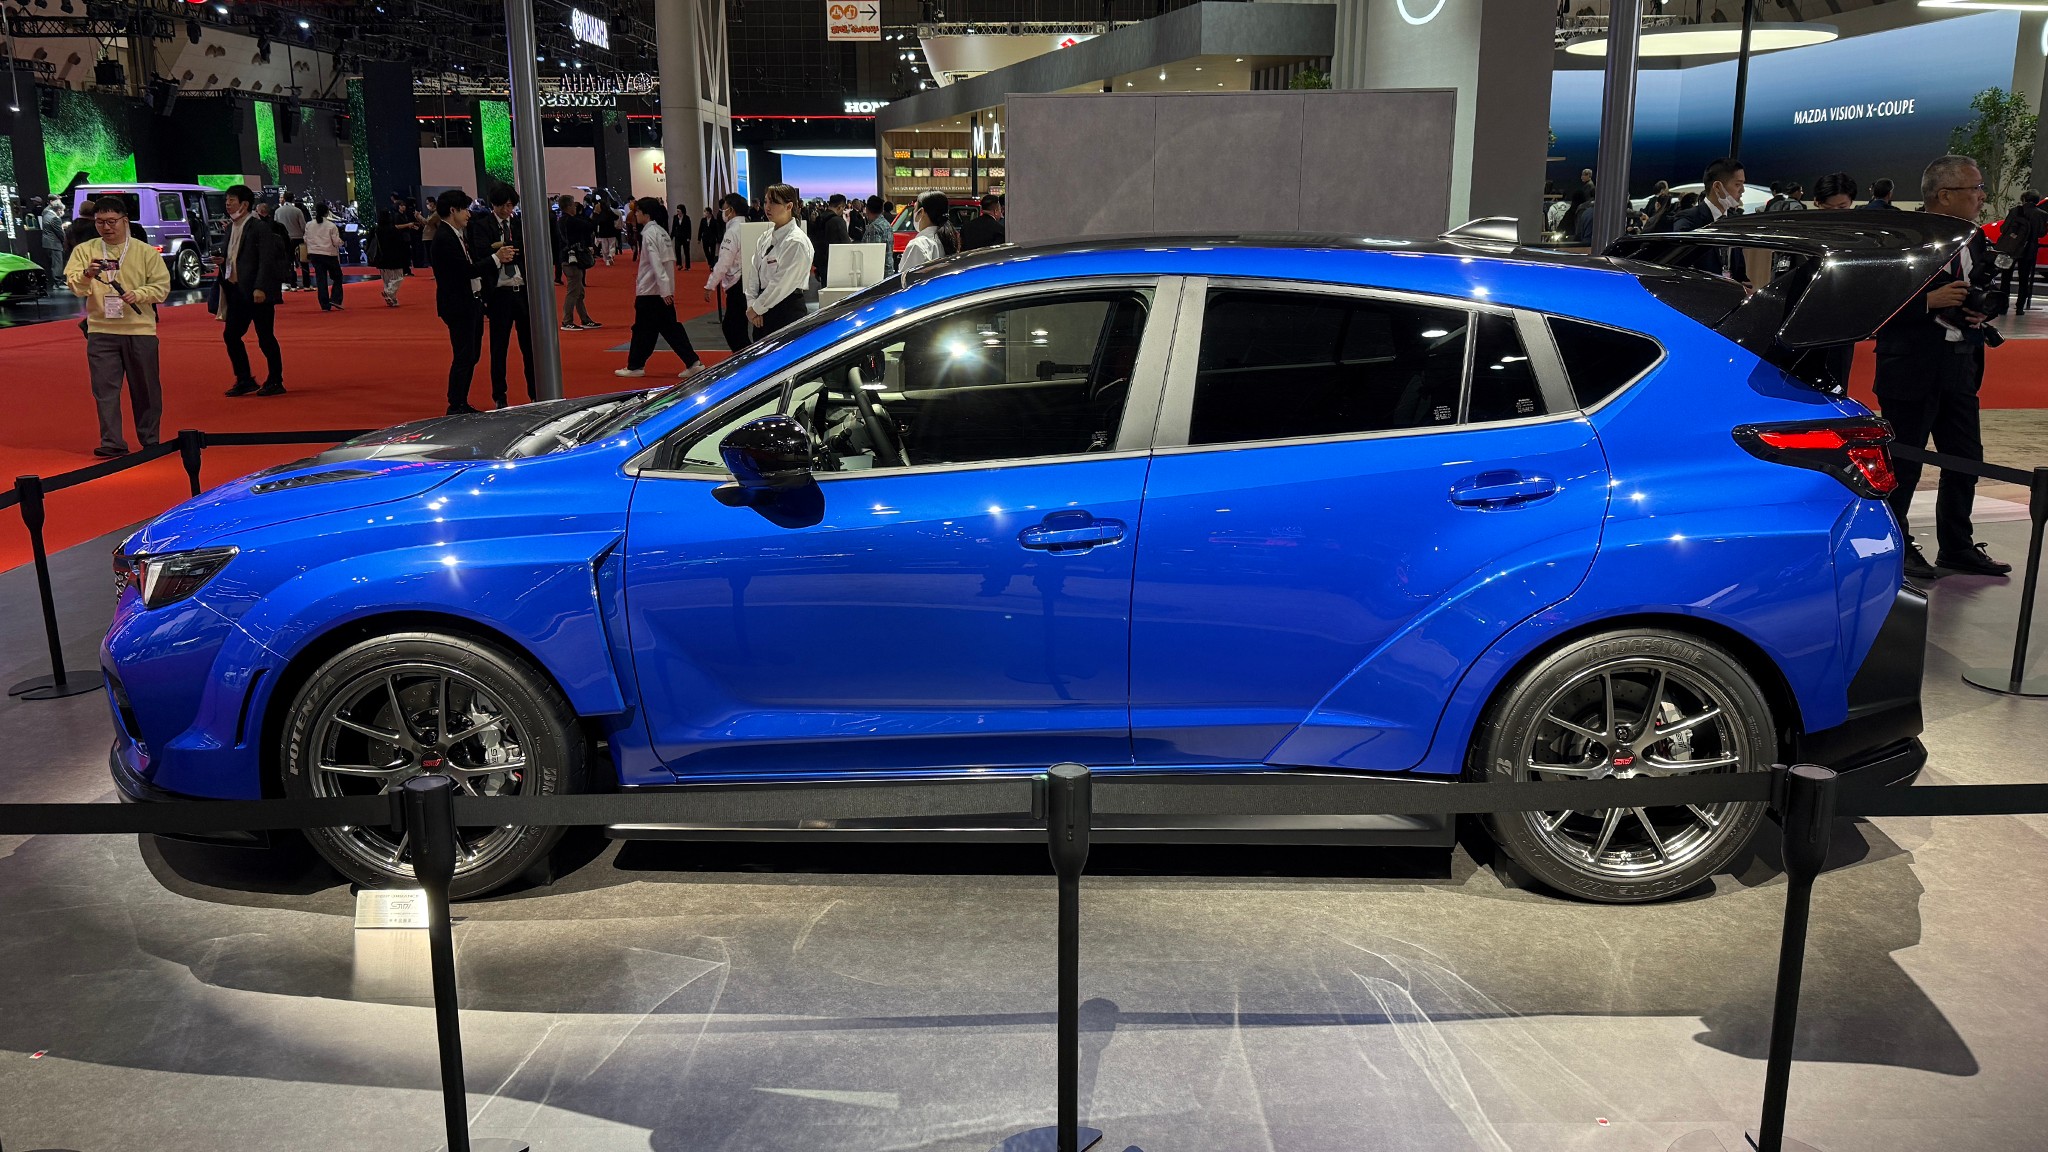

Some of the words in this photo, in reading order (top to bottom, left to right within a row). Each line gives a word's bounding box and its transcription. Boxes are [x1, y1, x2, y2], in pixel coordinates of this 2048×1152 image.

[580, 12, 610, 50] YAMAHA
[1793, 108, 1827, 125] MAZDA
[1830, 104, 1864, 121] VISION
[1866, 98, 1916, 118] X-COUPE
[1585, 638, 1704, 664] BRIDGESTONE
[289, 674, 337, 776] POTENZA
